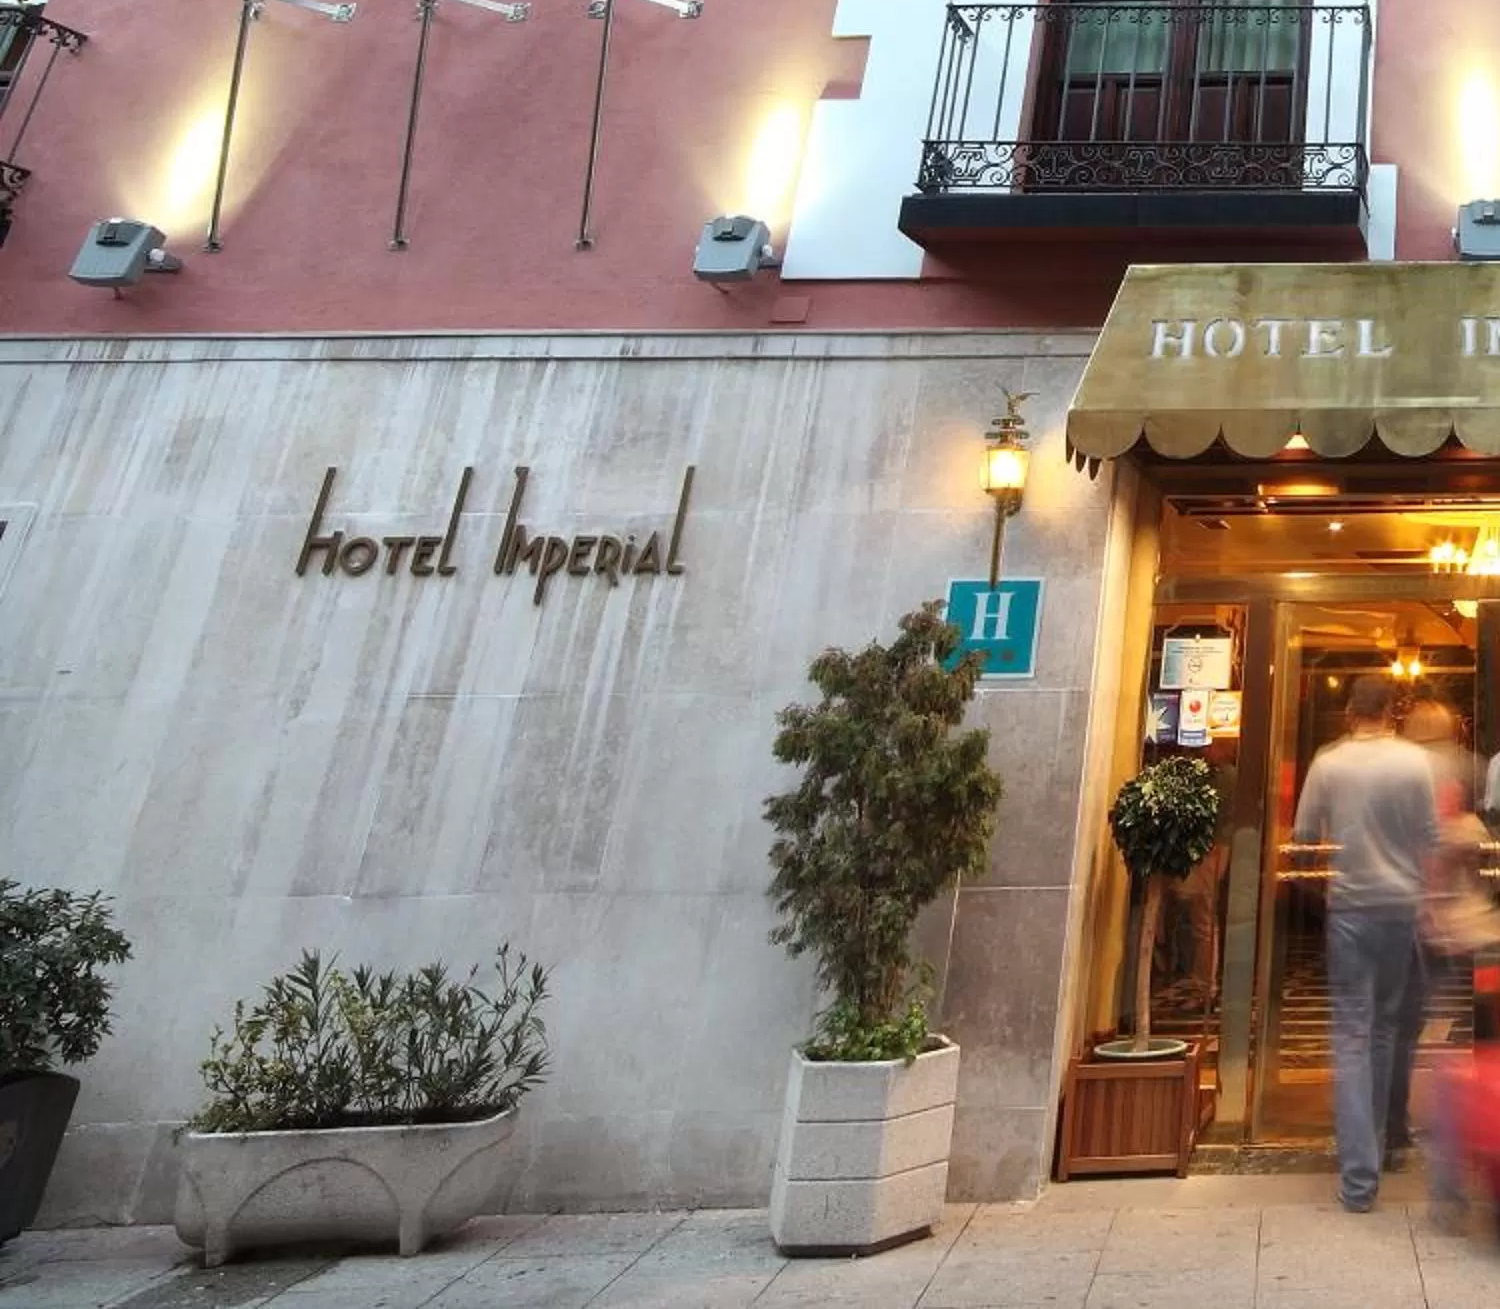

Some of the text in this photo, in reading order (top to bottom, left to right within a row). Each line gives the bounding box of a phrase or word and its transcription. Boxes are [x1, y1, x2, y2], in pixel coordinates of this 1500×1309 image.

[1150, 317, 1394, 359] HOTEL
[295, 466, 474, 577] HOTEL
[969, 592, 1015, 640] H
